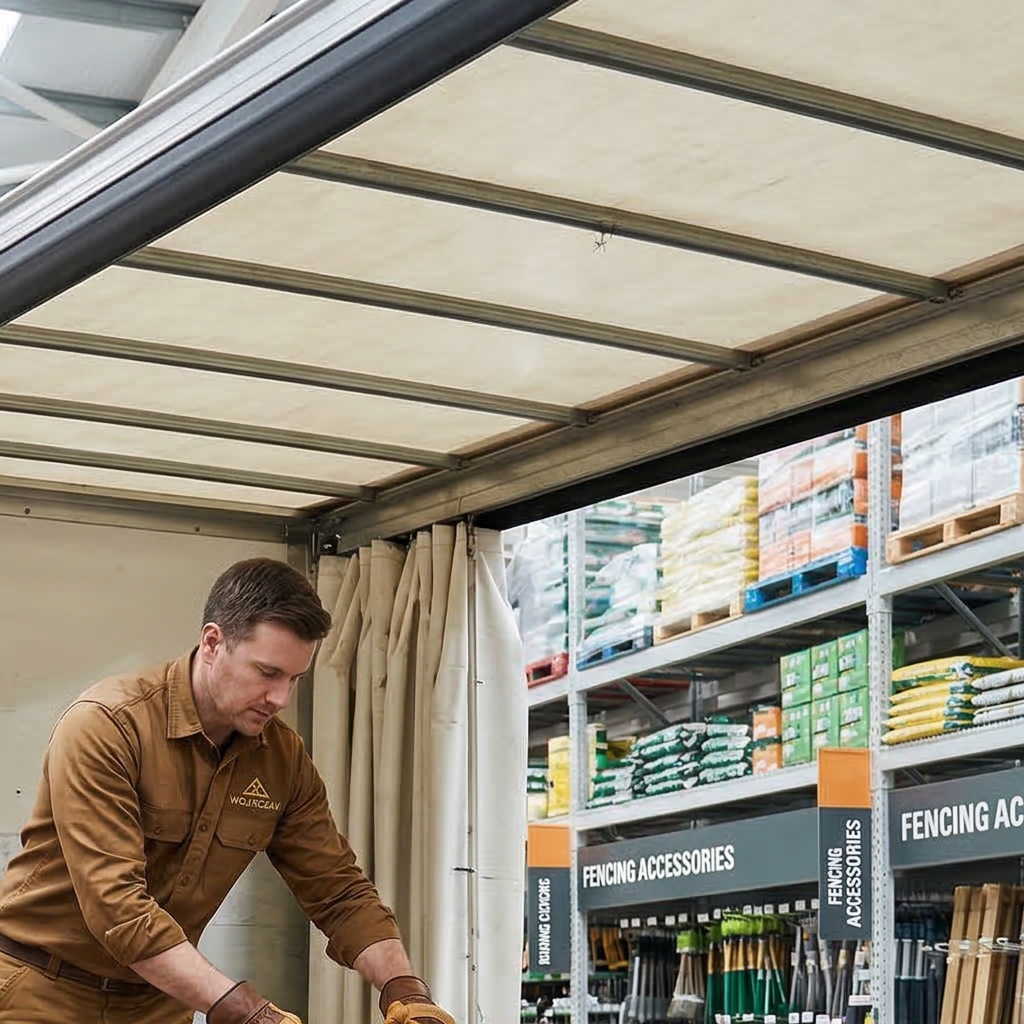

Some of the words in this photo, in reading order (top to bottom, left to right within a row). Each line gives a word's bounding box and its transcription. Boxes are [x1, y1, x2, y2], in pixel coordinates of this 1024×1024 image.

[901, 801, 989, 842] FENCING
[583, 859, 636, 888] FENCING
[637, 844, 735, 881] ACCESSORIES
[827, 847, 843, 905] FENCING
[846, 819, 862, 928] ACCESSORIES
